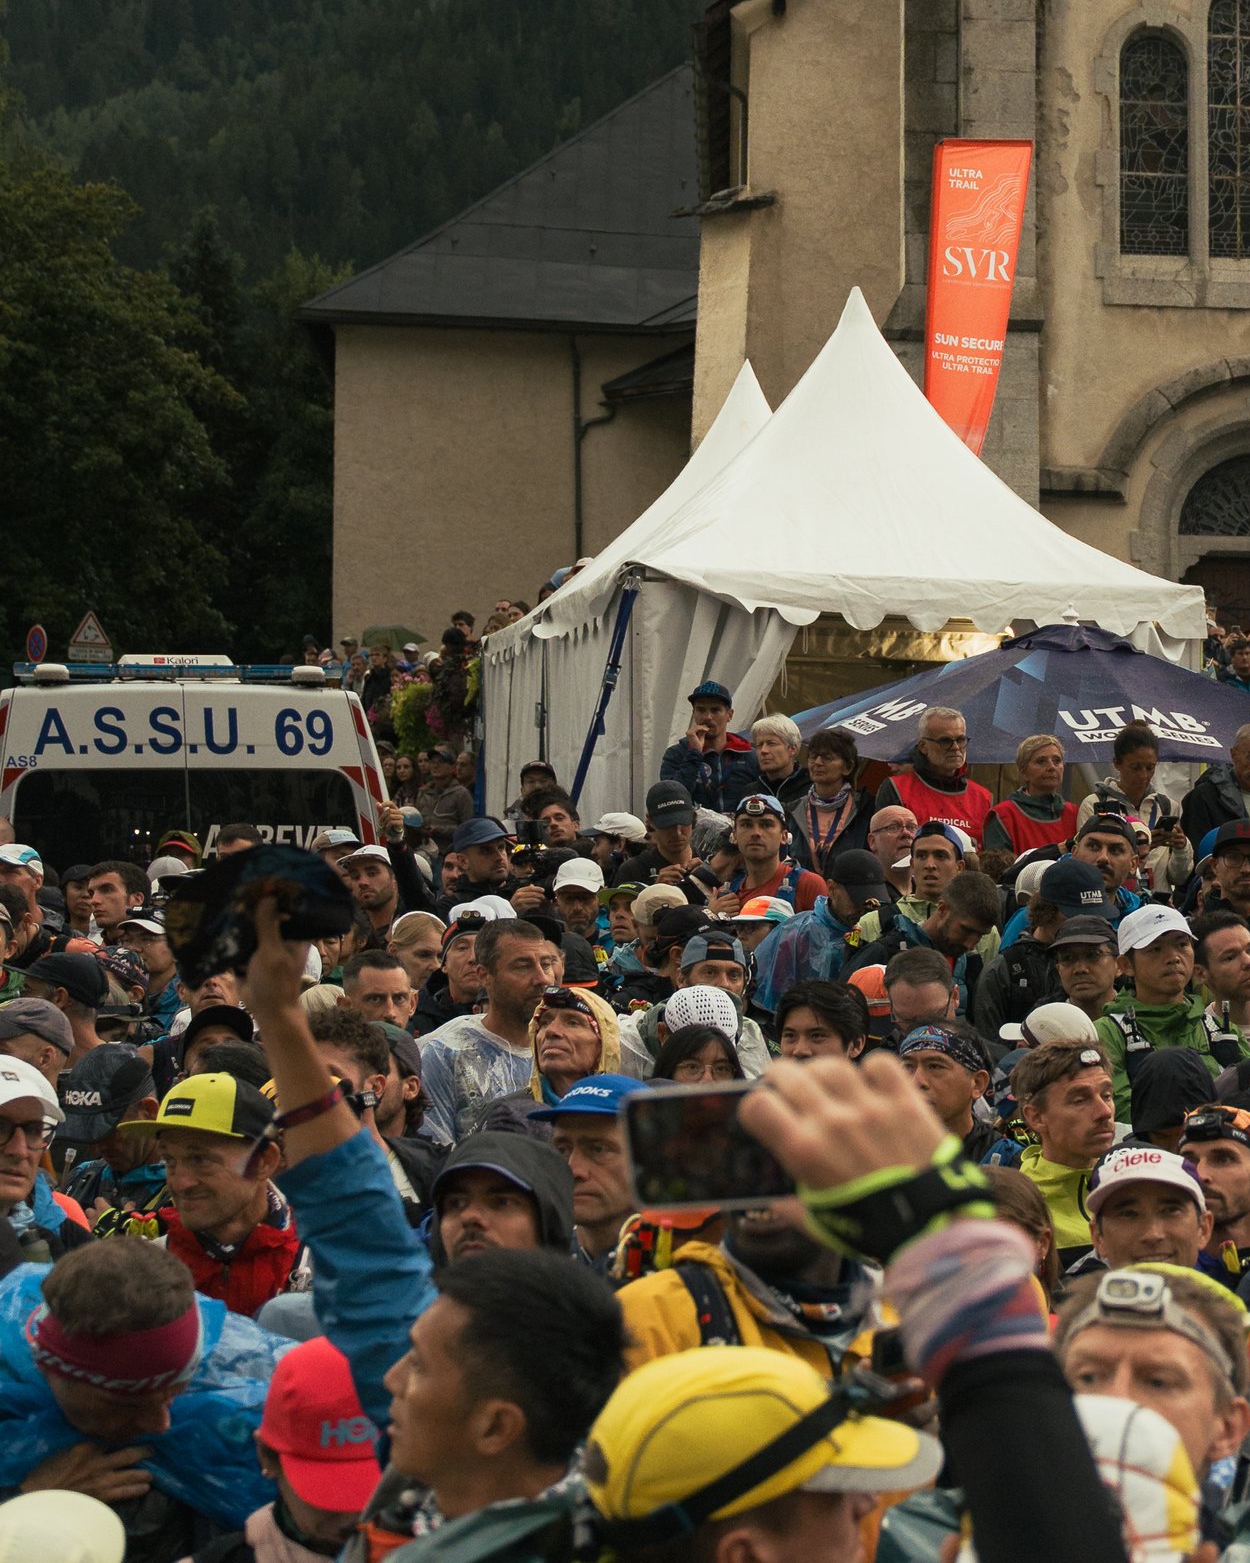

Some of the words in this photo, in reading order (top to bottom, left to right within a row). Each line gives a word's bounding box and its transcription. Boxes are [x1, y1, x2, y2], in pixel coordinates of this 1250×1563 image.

[949, 168, 983, 179] ULTRA
[948, 179, 979, 190] TRAIL
[943, 246, 1010, 281] SVR
[935, 332, 959, 347] SUN
[931, 350, 955, 362] ULTRA
[942, 361, 969, 373] ULTRA
[971, 365, 994, 375] TRAIL
[167, 657, 199, 665] Kalori
[34, 706, 255, 755] A.S.S.U.
[275, 708, 333, 756] 69
[1161, 729, 1215, 745] SERIES
[6, 755, 37, 768] AS8
[1080, 890, 1102, 899] UTMB
[65, 1090, 102, 1106] HOKA
[1113, 1151, 1162, 1173] ciele
